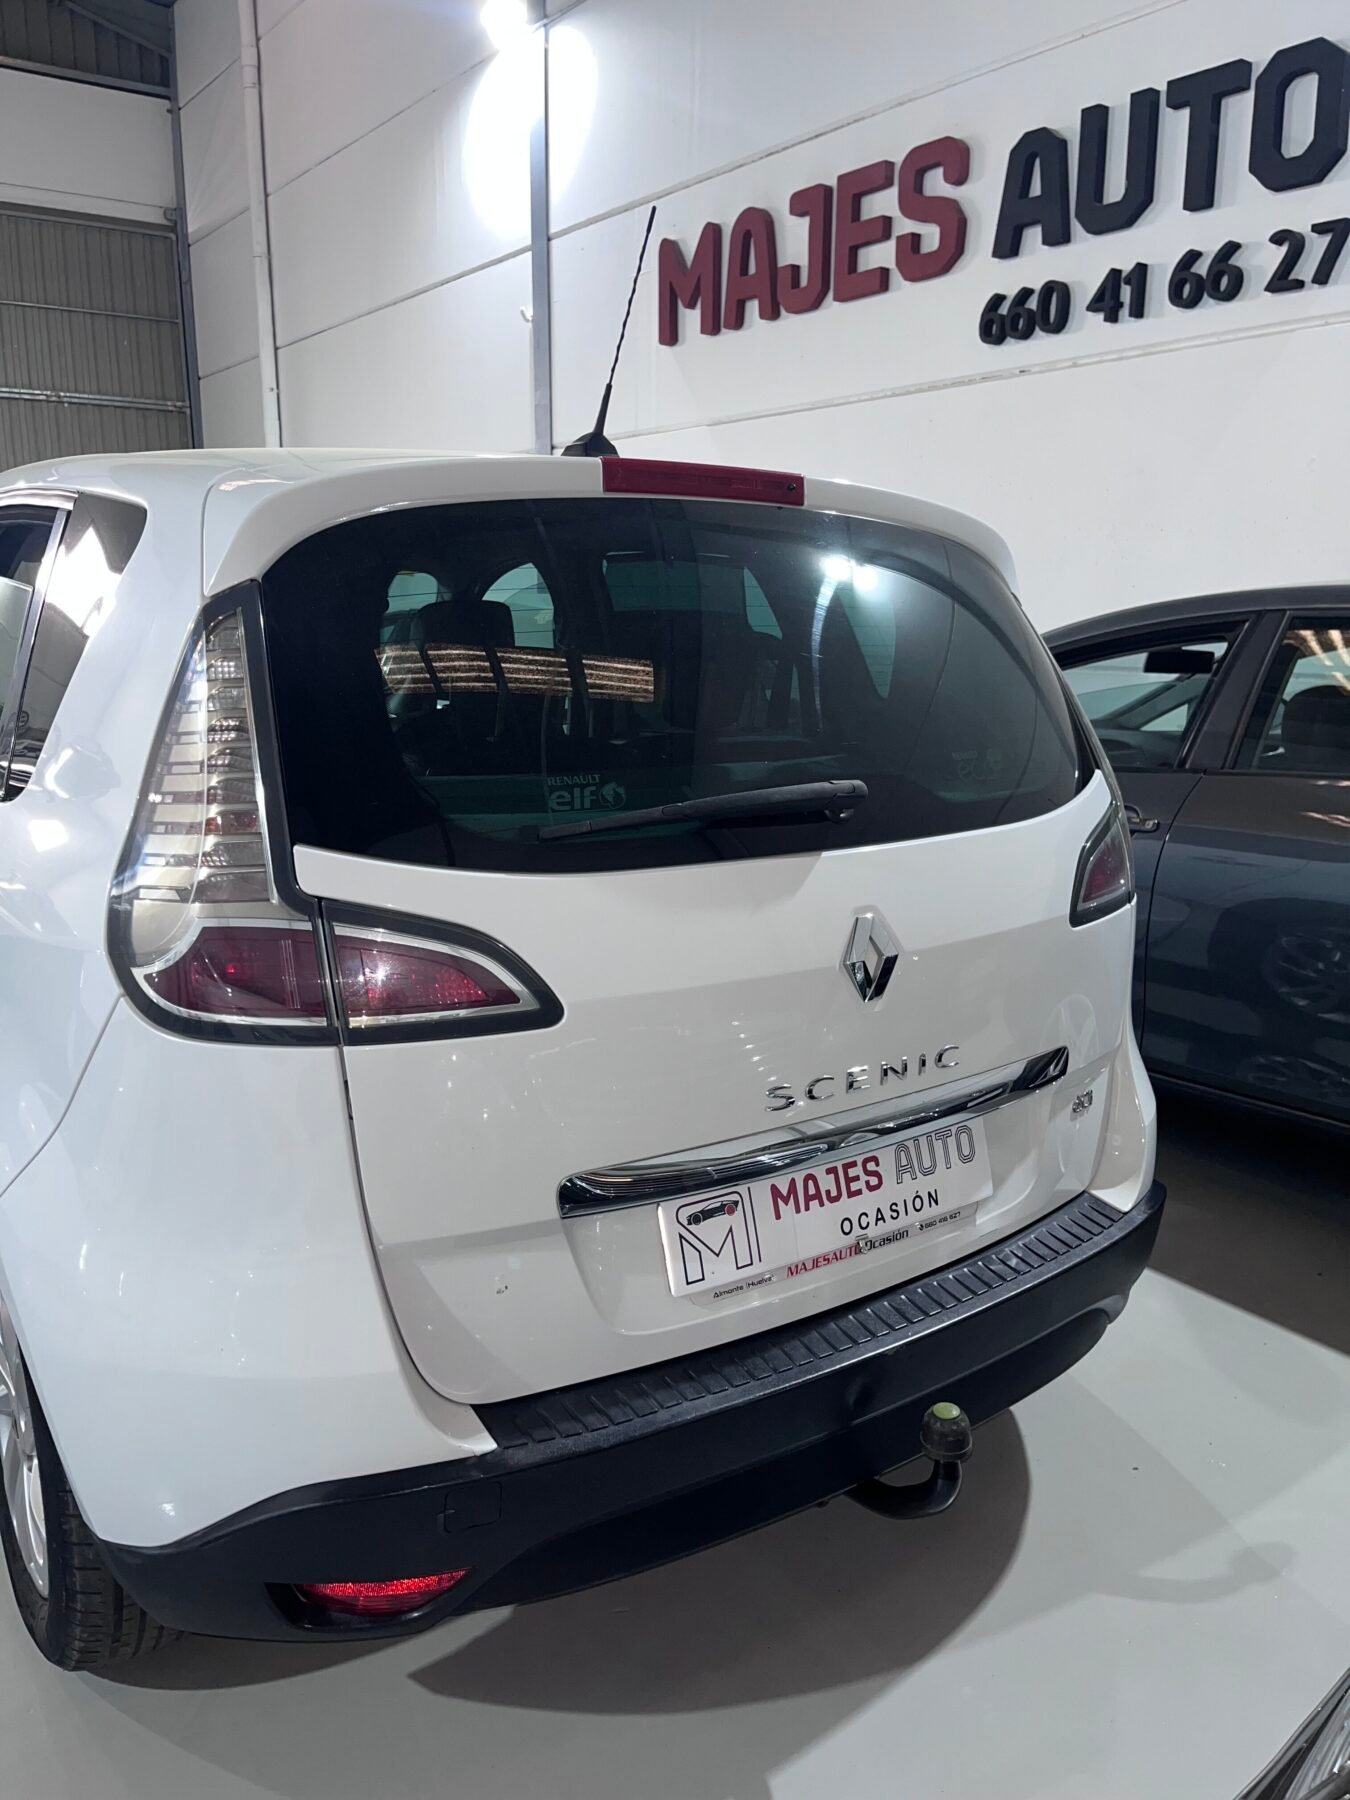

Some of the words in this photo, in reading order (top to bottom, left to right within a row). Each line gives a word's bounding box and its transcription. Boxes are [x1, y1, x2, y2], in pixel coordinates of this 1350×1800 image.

[658, 136, 970, 346] MAJES
[991, 37, 1350, 260] AUTO
[979, 280, 1070, 345] 660
[1086, 262, 1148, 323] 41
[1168, 241, 1243, 309] 66
[1264, 218, 1350, 295] 27
[547, 774, 600, 786] RENAULT
[550, 786, 597, 810] elf
[765, 1044, 960, 1112] SCENIC
[770, 1155, 884, 1220] MAJES
[894, 1125, 976, 1184] AUTO
[840, 1190, 939, 1236] OCASIÓN
[713, 1284, 744, 1299] Almonte
